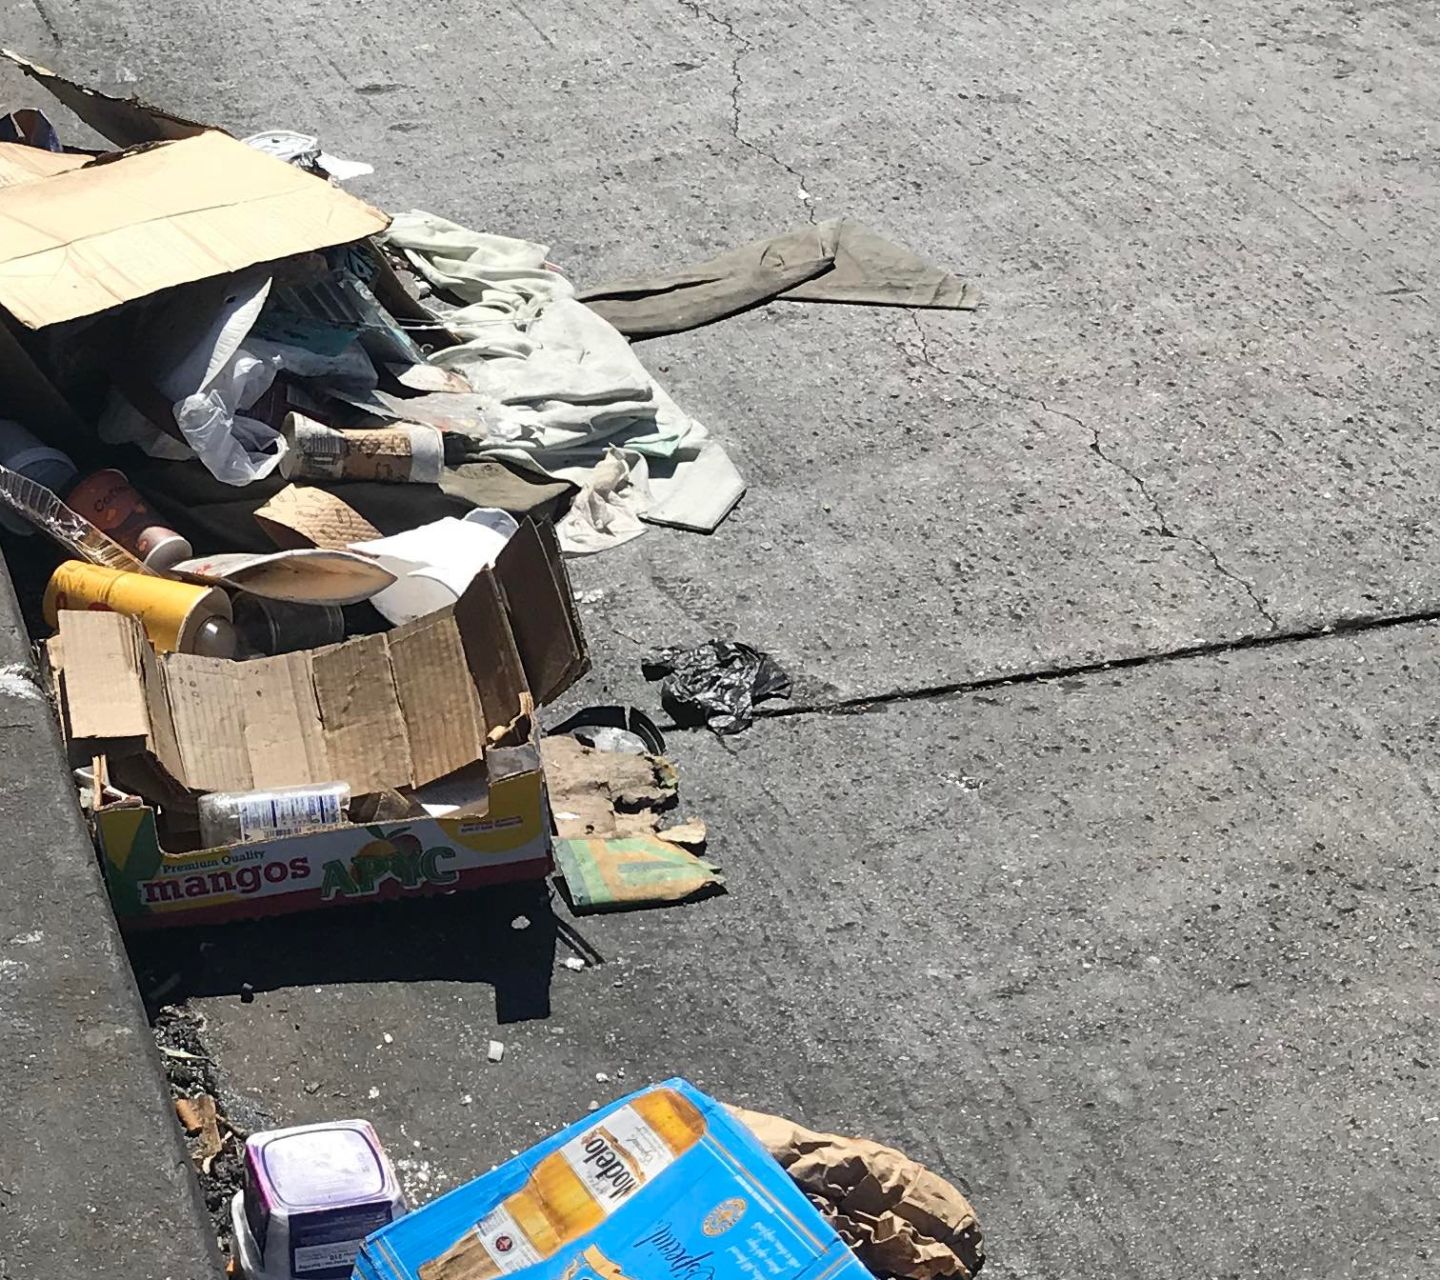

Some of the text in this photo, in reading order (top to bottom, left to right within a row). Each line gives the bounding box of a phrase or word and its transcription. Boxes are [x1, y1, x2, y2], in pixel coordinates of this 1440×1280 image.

[142, 855, 310, 902] mangos
[163, 849, 266, 874] Premium Quality
[583, 1137, 636, 1203] Modelo
